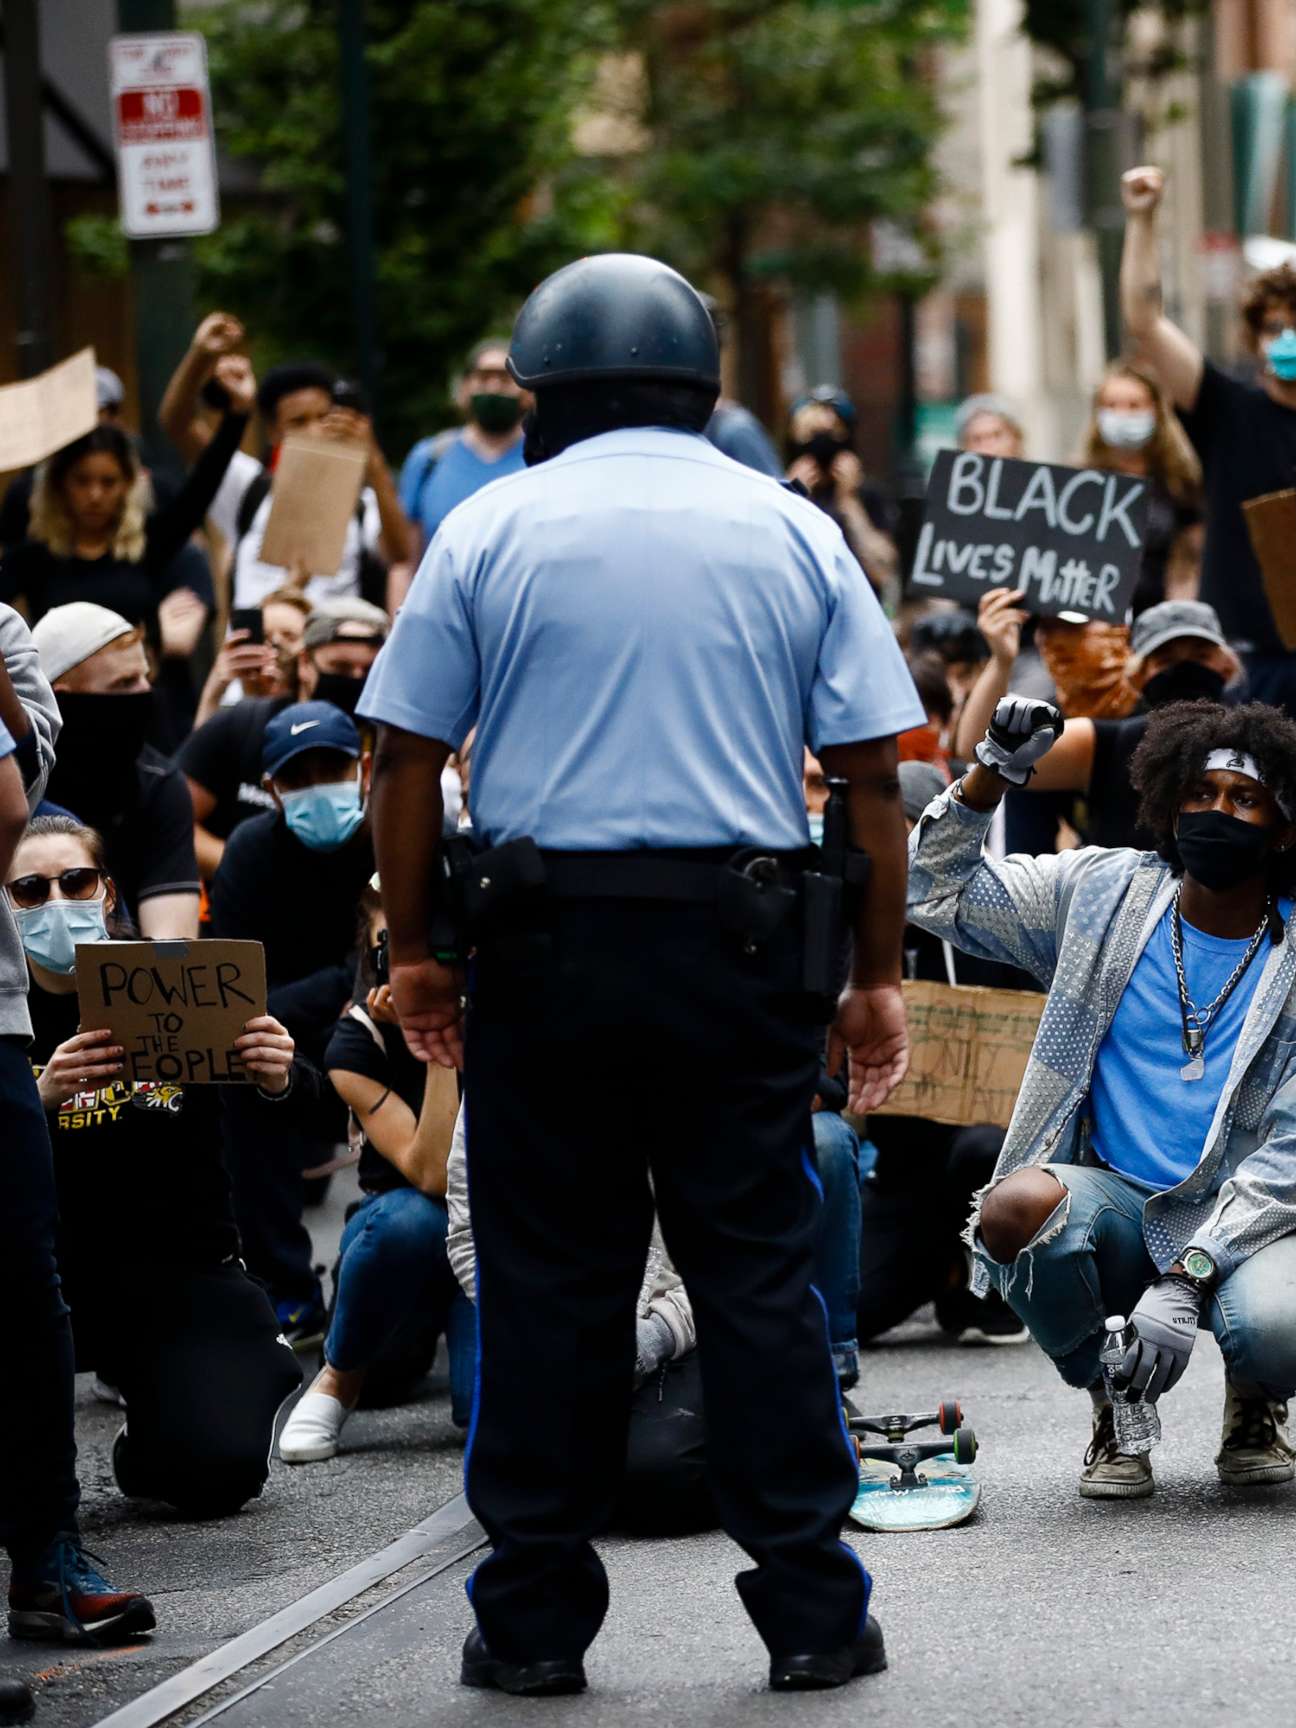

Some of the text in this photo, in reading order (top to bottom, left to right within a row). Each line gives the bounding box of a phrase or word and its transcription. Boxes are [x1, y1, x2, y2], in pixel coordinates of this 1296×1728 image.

[946, 451, 1145, 548] BLACK
[99, 962, 256, 1009] POWER
[149, 1012, 184, 1034] TO
[136, 1034, 180, 1056] THE
[130, 1048, 248, 1082] EOPLE
